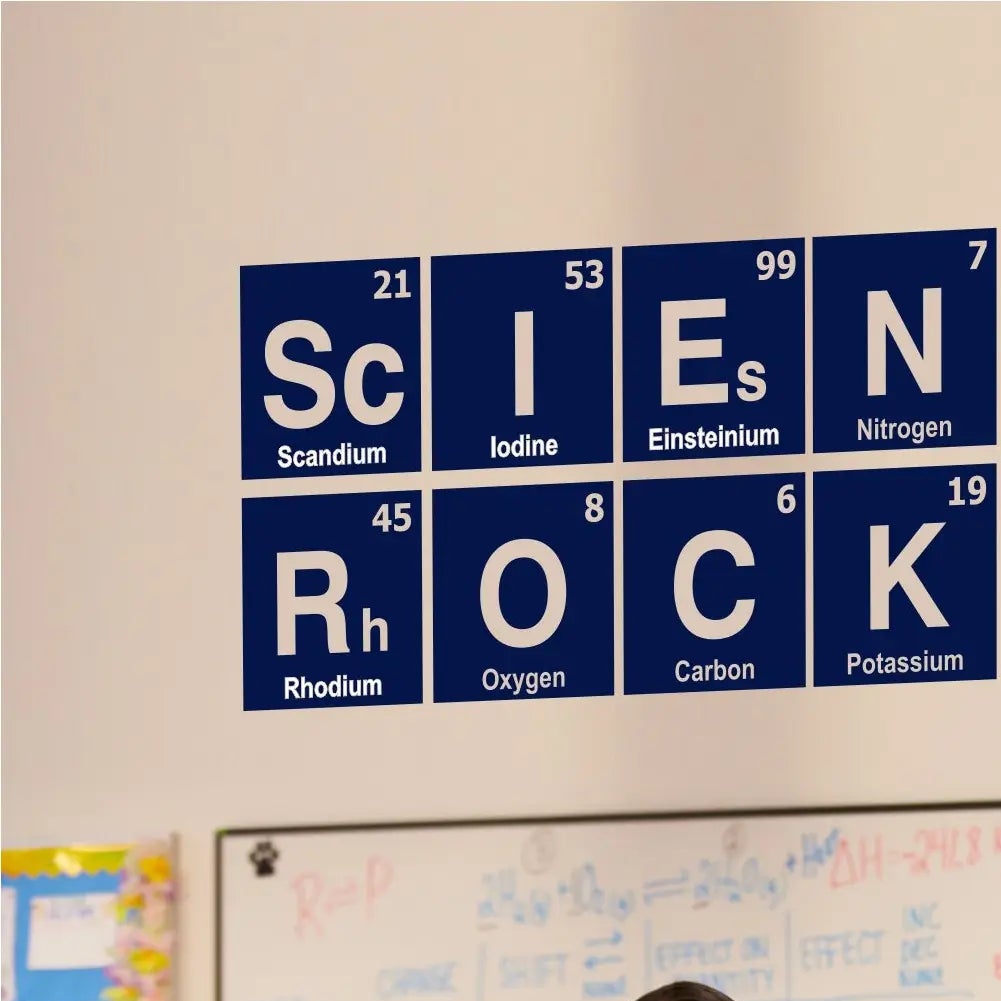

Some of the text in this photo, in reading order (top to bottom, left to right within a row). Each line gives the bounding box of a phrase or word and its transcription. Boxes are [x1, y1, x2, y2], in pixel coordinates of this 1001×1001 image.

[756, 249, 796, 281] 99
[968, 240, 988, 270] 7
[373, 269, 412, 300] 21
[565, 259, 604, 291] 53
[263, 319, 405, 430] Sc
[514, 310, 535, 417] I
[867, 287, 942, 397] N
[490, 433, 559, 459] Iodine
[648, 423, 780, 451] Einsteinium
[857, 418, 952, 444] Nitrogen
[277, 442, 387, 469] Scandium
[776, 483, 797, 514] 6
[948, 475, 987, 506] 19
[371, 502, 412, 533] 45
[584, 492, 605, 523] 8
[479, 538, 567, 649] O
[673, 529, 756, 640] C
[869, 522, 950, 631] K
[674, 658, 755, 683] Carbon
[847, 652, 964, 675] Potassium
[284, 674, 383, 700] Rhodium
[482, 668, 565, 696] Oxygen
